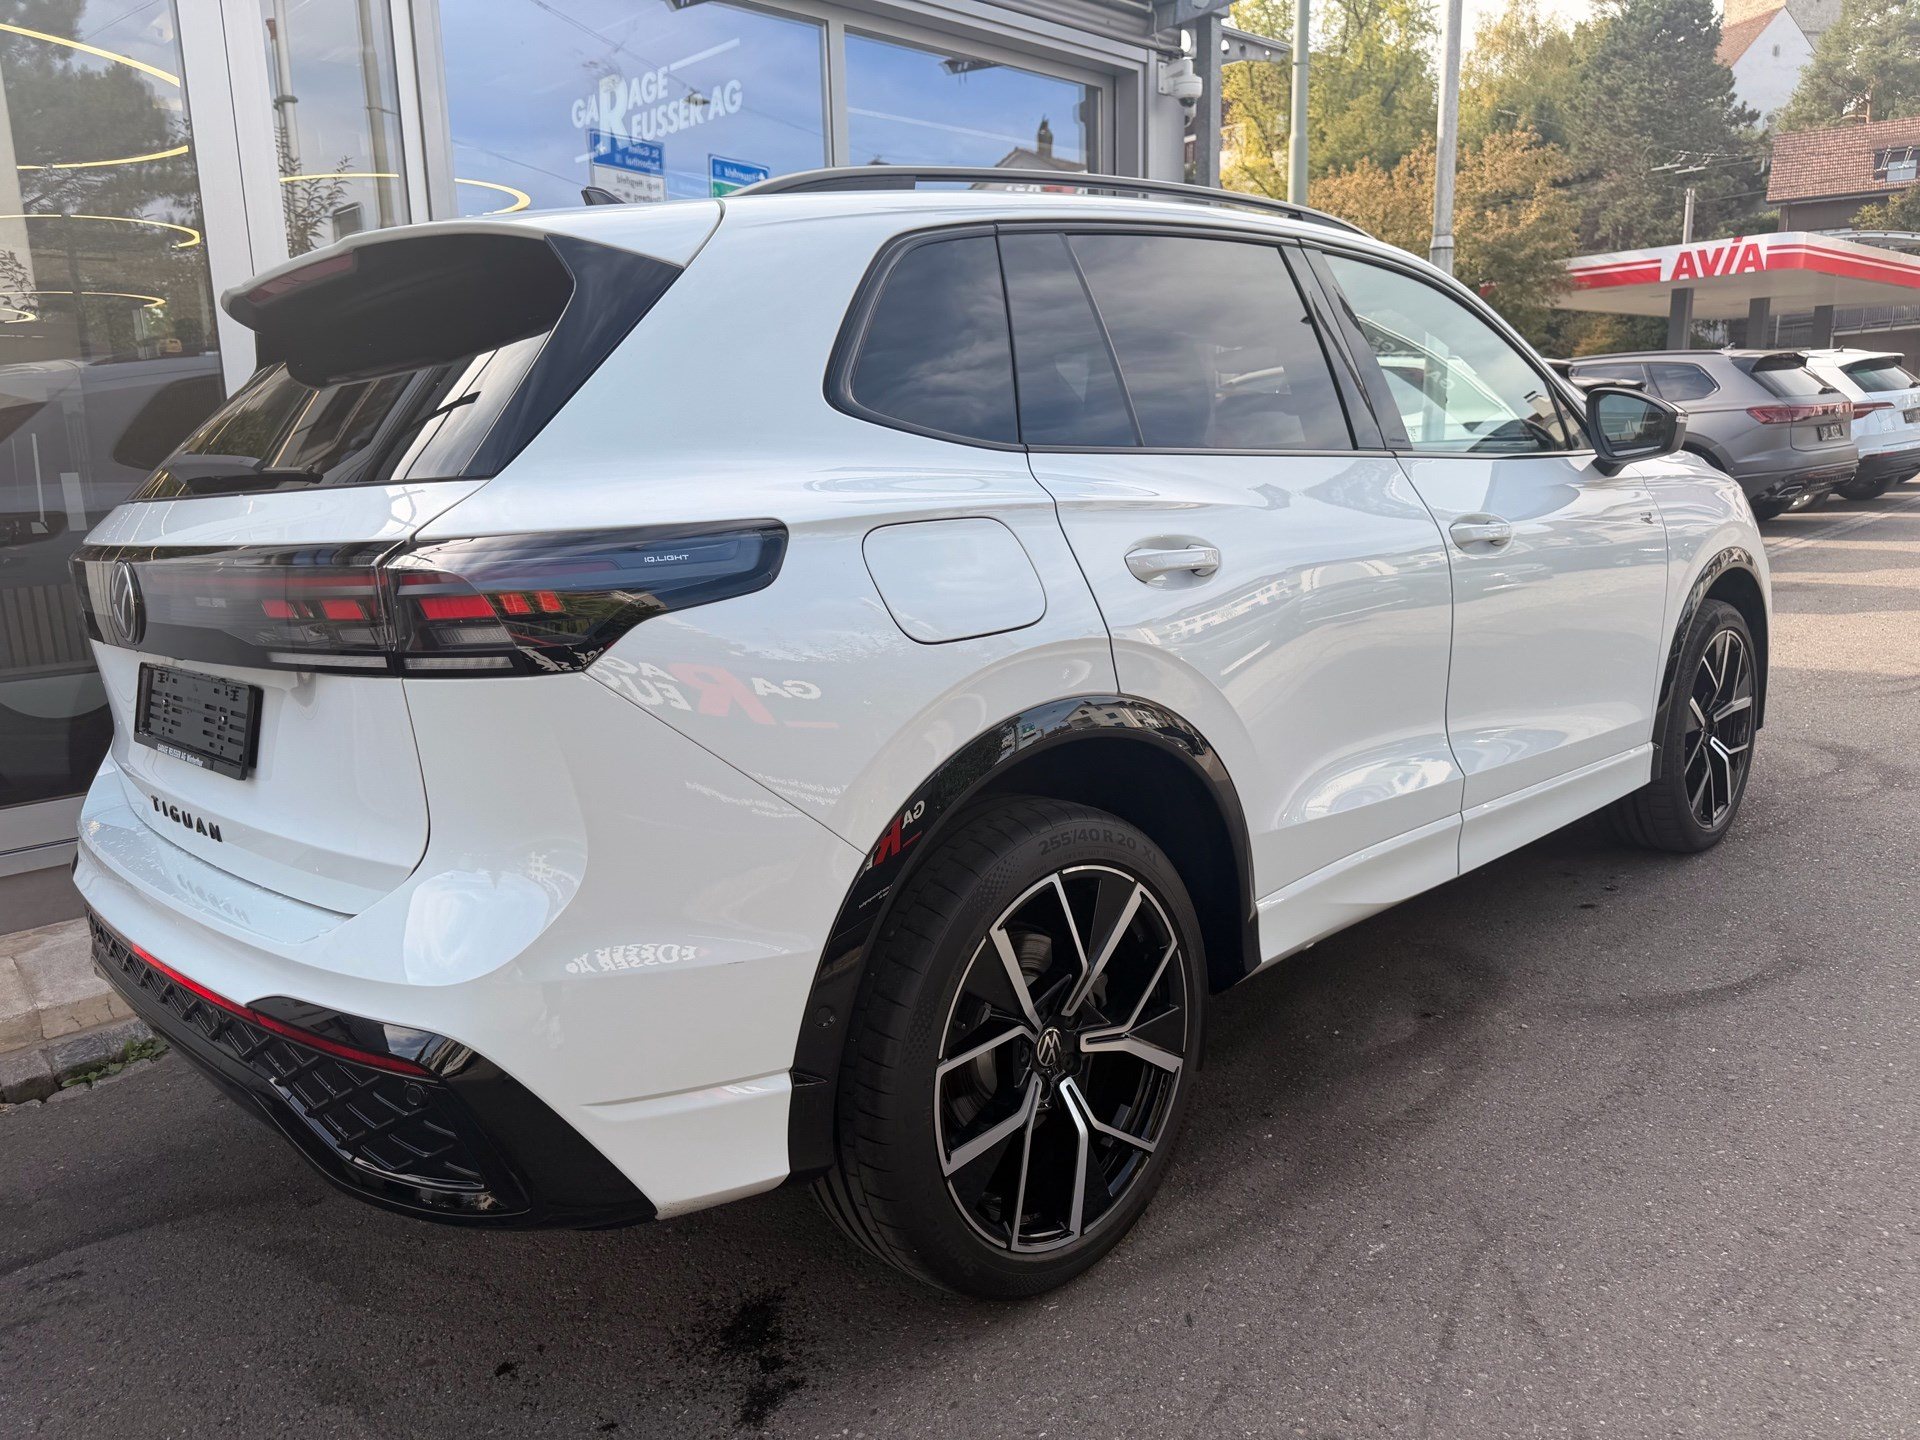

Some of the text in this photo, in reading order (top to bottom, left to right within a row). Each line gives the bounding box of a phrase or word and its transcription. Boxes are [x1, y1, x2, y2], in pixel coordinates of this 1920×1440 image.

[707, 79, 743, 120] AG
[644, 554, 690, 563] IQ.LIGHT
[151, 795, 223, 842] TIGUAN
[1038, 828, 1100, 855] 255/40
[1103, 829, 1115, 843] R
[1117, 832, 1137, 851] 20
